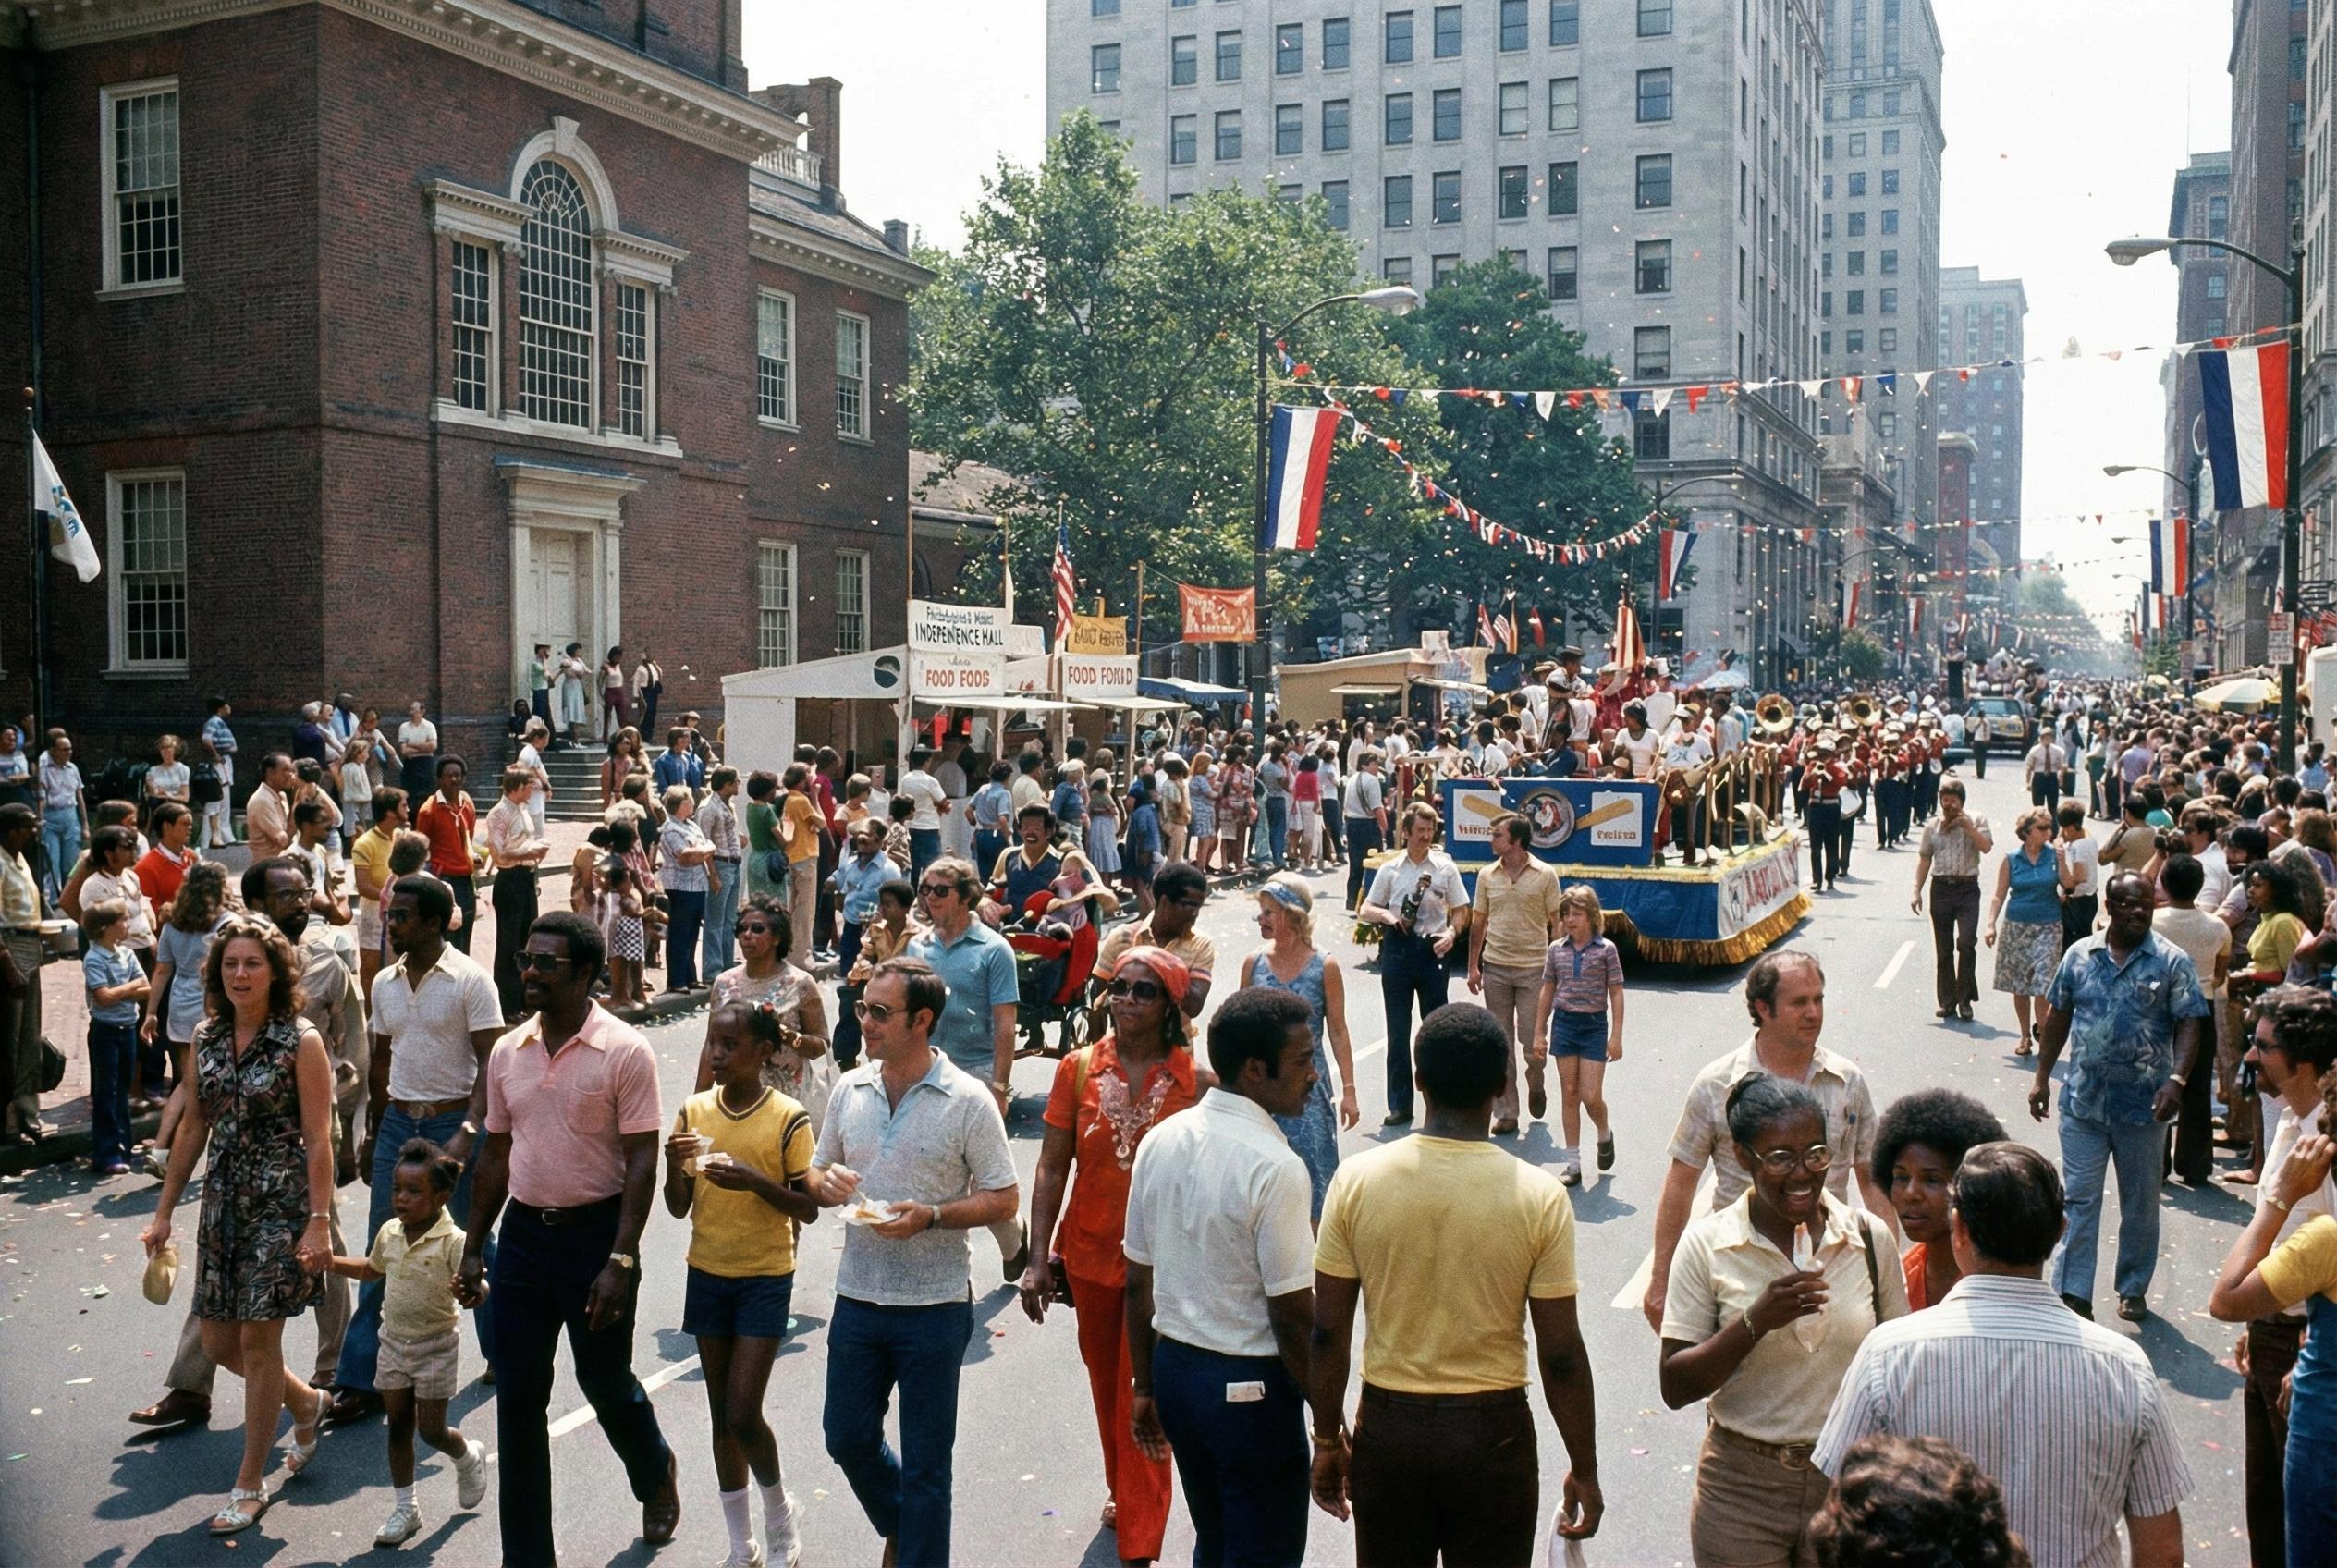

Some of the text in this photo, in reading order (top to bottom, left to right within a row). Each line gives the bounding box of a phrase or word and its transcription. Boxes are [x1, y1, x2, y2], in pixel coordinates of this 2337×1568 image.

[982, 627, 1003, 645] HALL
[925, 669, 955, 688] FOOD
[1068, 666, 1096, 685] FOOD
